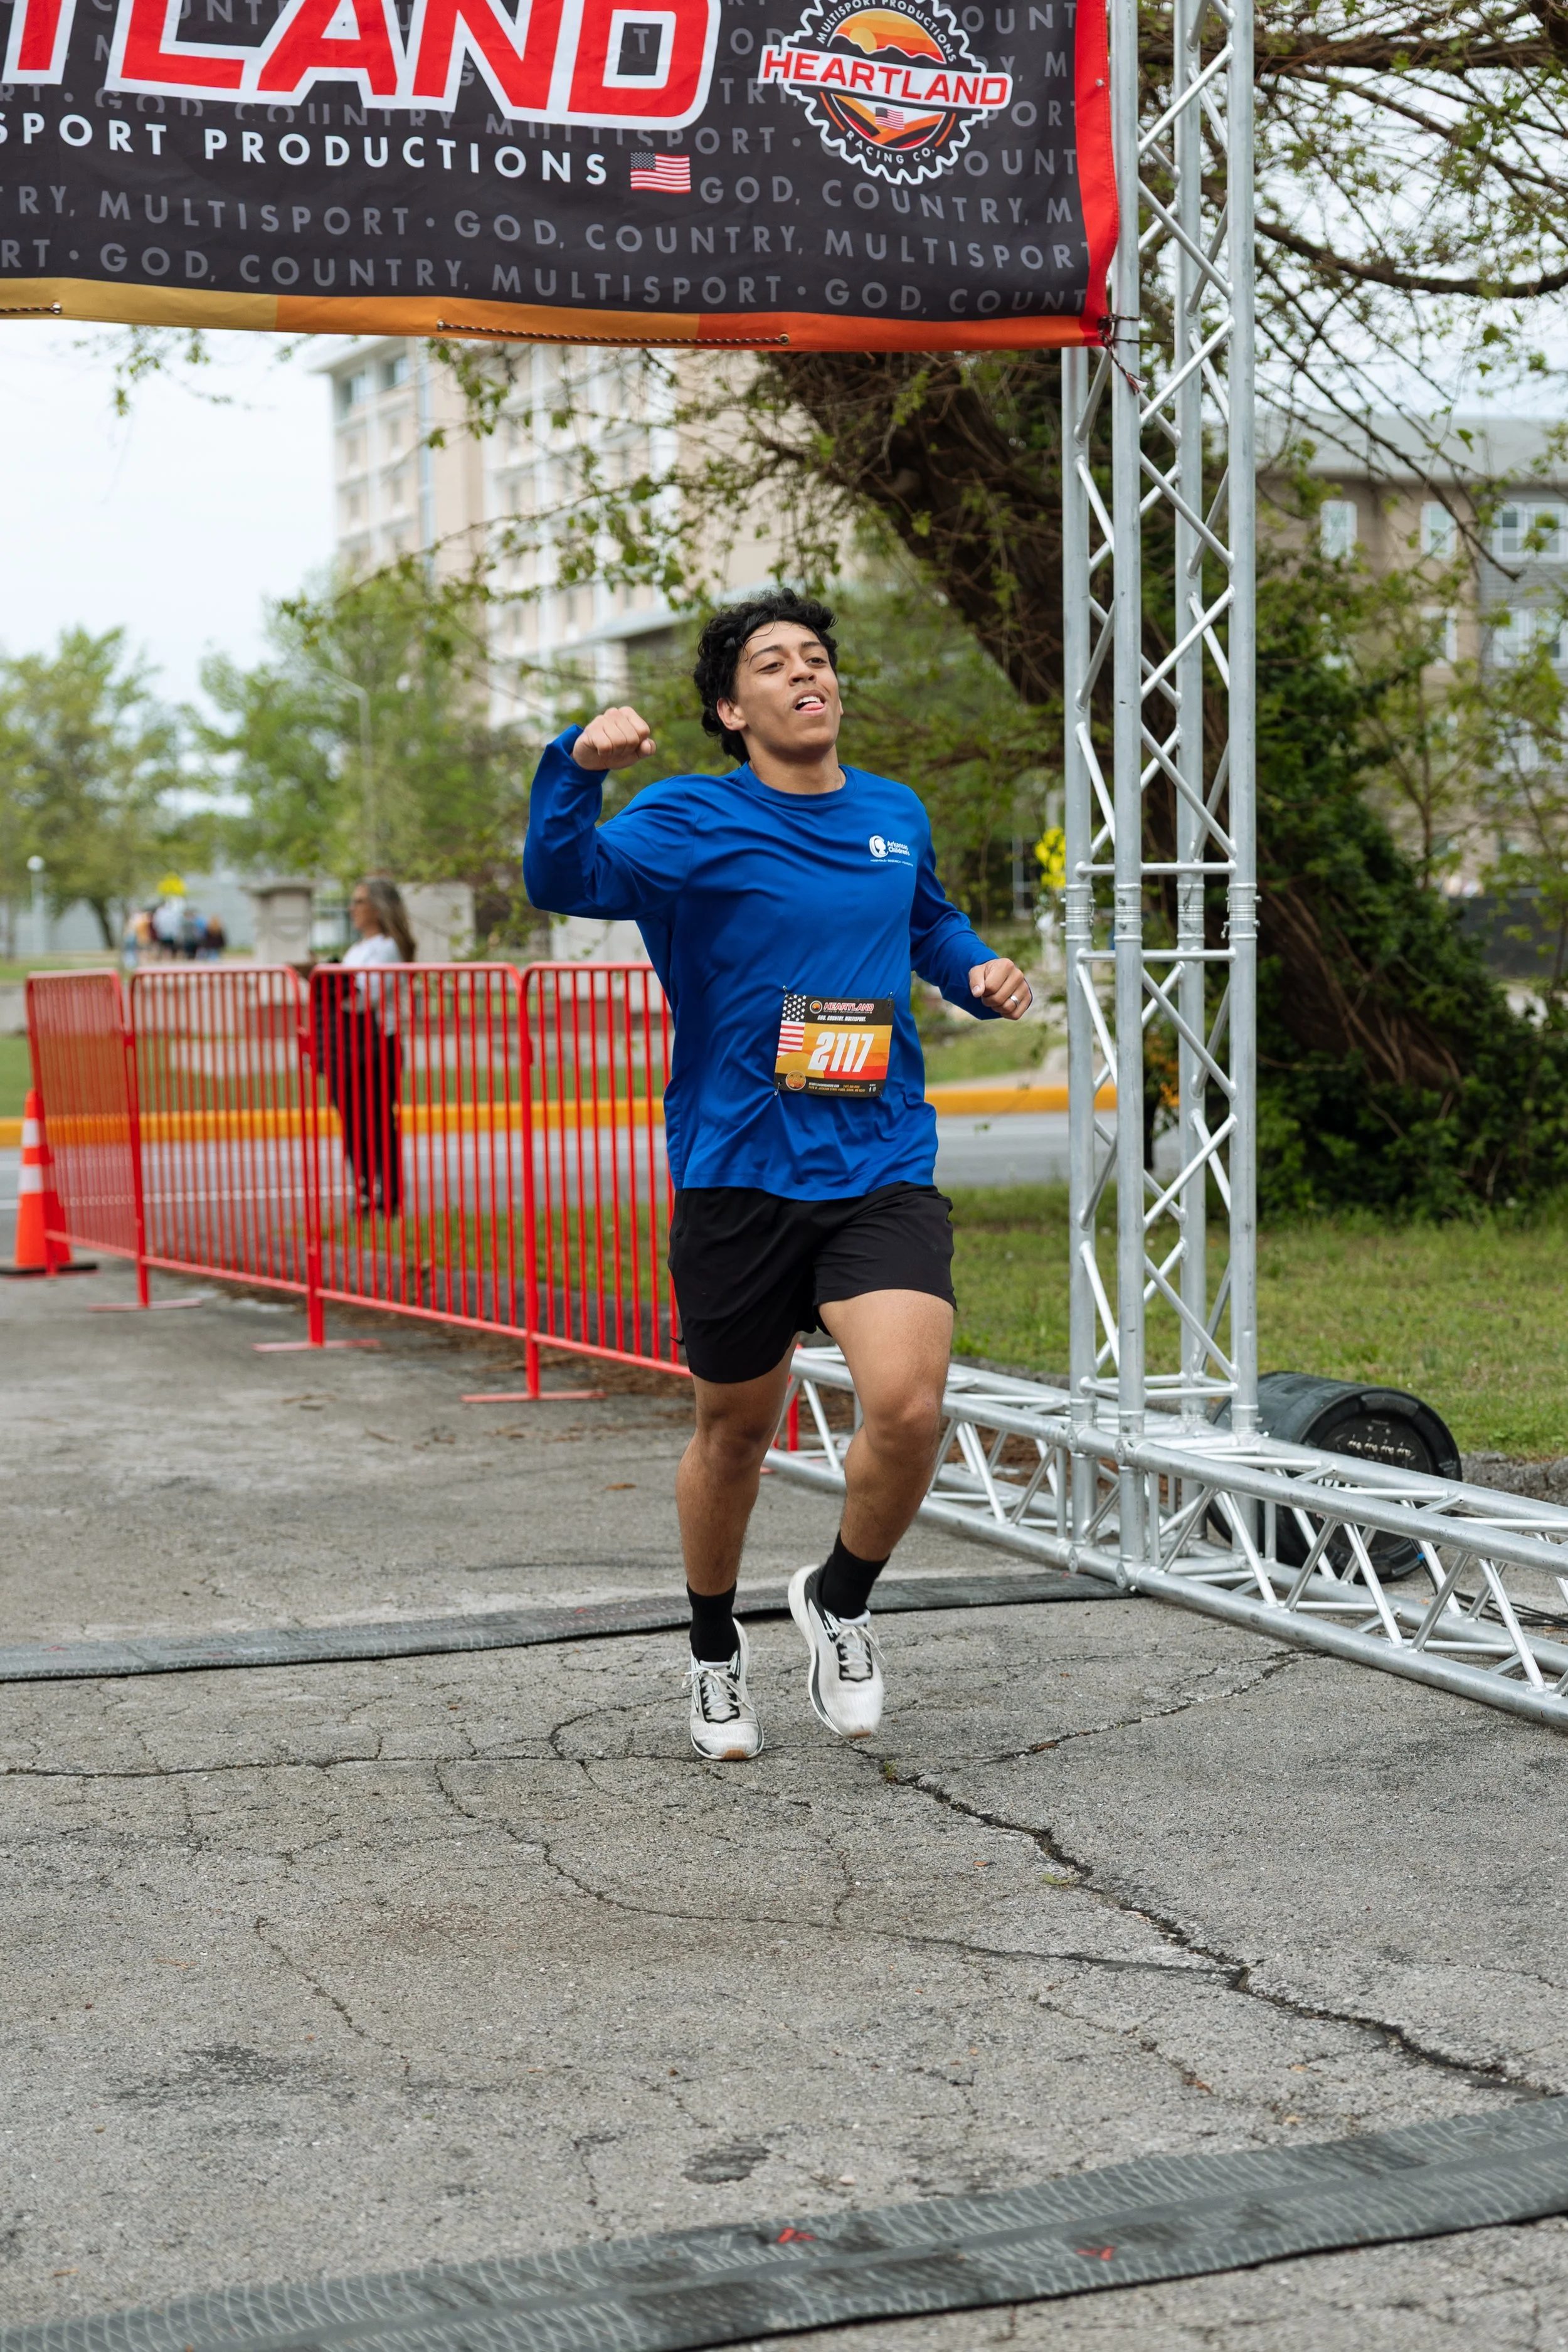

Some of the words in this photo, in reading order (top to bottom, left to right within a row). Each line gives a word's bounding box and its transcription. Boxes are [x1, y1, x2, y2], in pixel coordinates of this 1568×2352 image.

[940, 3, 1077, 34] OUNT
[763, 50, 1009, 105] HEARTLAND
[204, 129, 607, 185] PRODUCTIONS
[845, 130, 904, 164] RACING
[913, 148, 935, 161] CO.
[942, 149, 1078, 176] OUNT
[0, 186, 75, 216] RY,
[99, 191, 409, 235] MULTISPORT
[455, 209, 564, 248] GOD,
[586, 224, 803, 255] COUNTRY,
[700, 176, 800, 205] GOD,
[822, 179, 1029, 225] COUNTRY,
[100, 243, 216, 282] GOD,
[240, 255, 469, 290] COUNTRY,
[492, 265, 781, 304] MULTISPORT
[825, 278, 928, 314] GOD,
[823, 1002, 875, 1012] HEARTLAND
[807, 1032, 874, 1073] 2117
